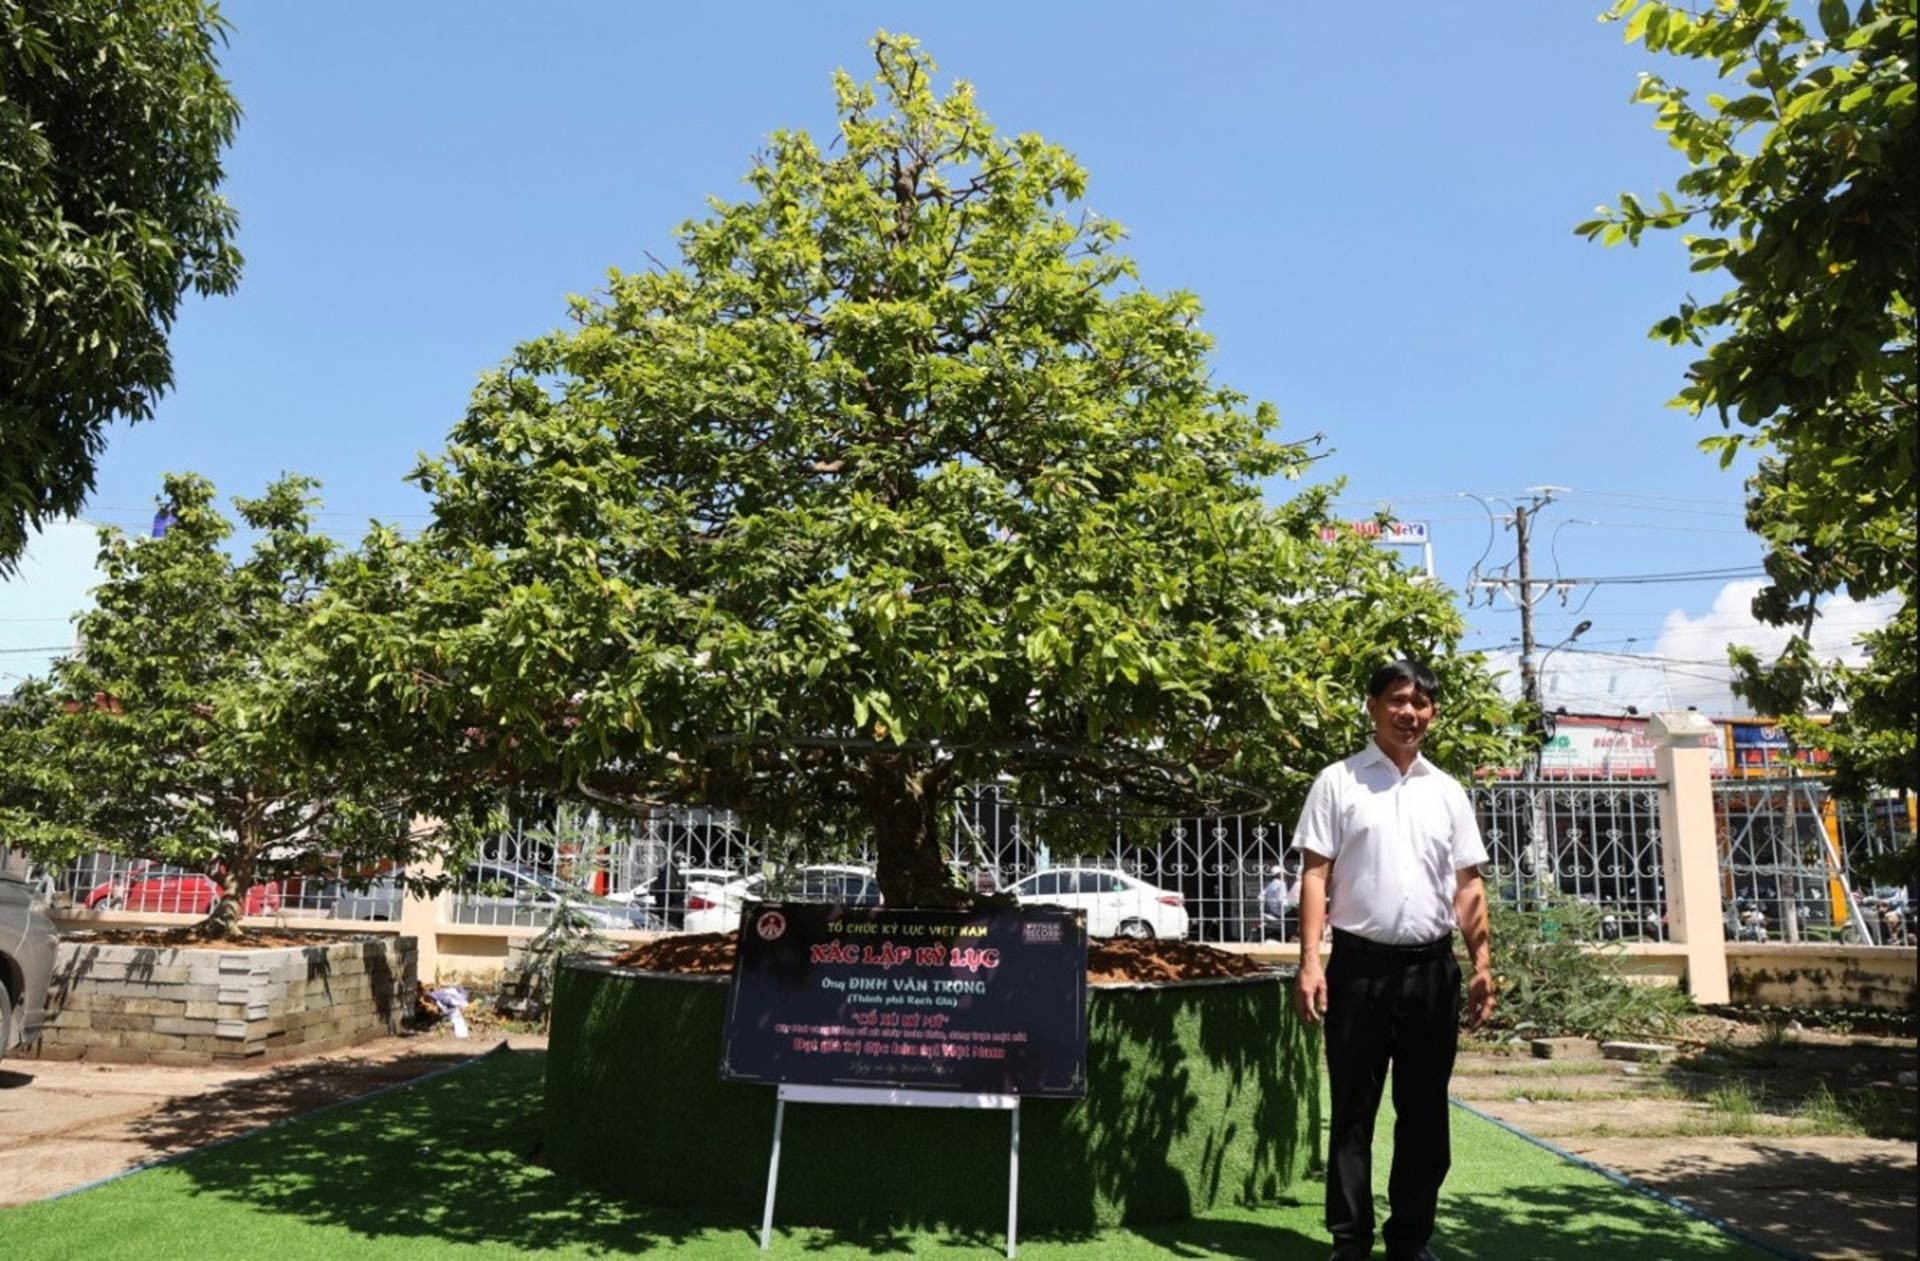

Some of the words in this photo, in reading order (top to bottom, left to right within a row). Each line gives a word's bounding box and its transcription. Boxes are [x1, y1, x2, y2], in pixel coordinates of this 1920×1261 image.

[959, 926, 988, 937] NAM
[810, 940, 860, 964] XÁC
[863, 940, 912, 970] LẬP
[950, 946, 999, 972] LỤC
[893, 976, 927, 992] VĂN
[933, 979, 986, 995] TRỌNG
